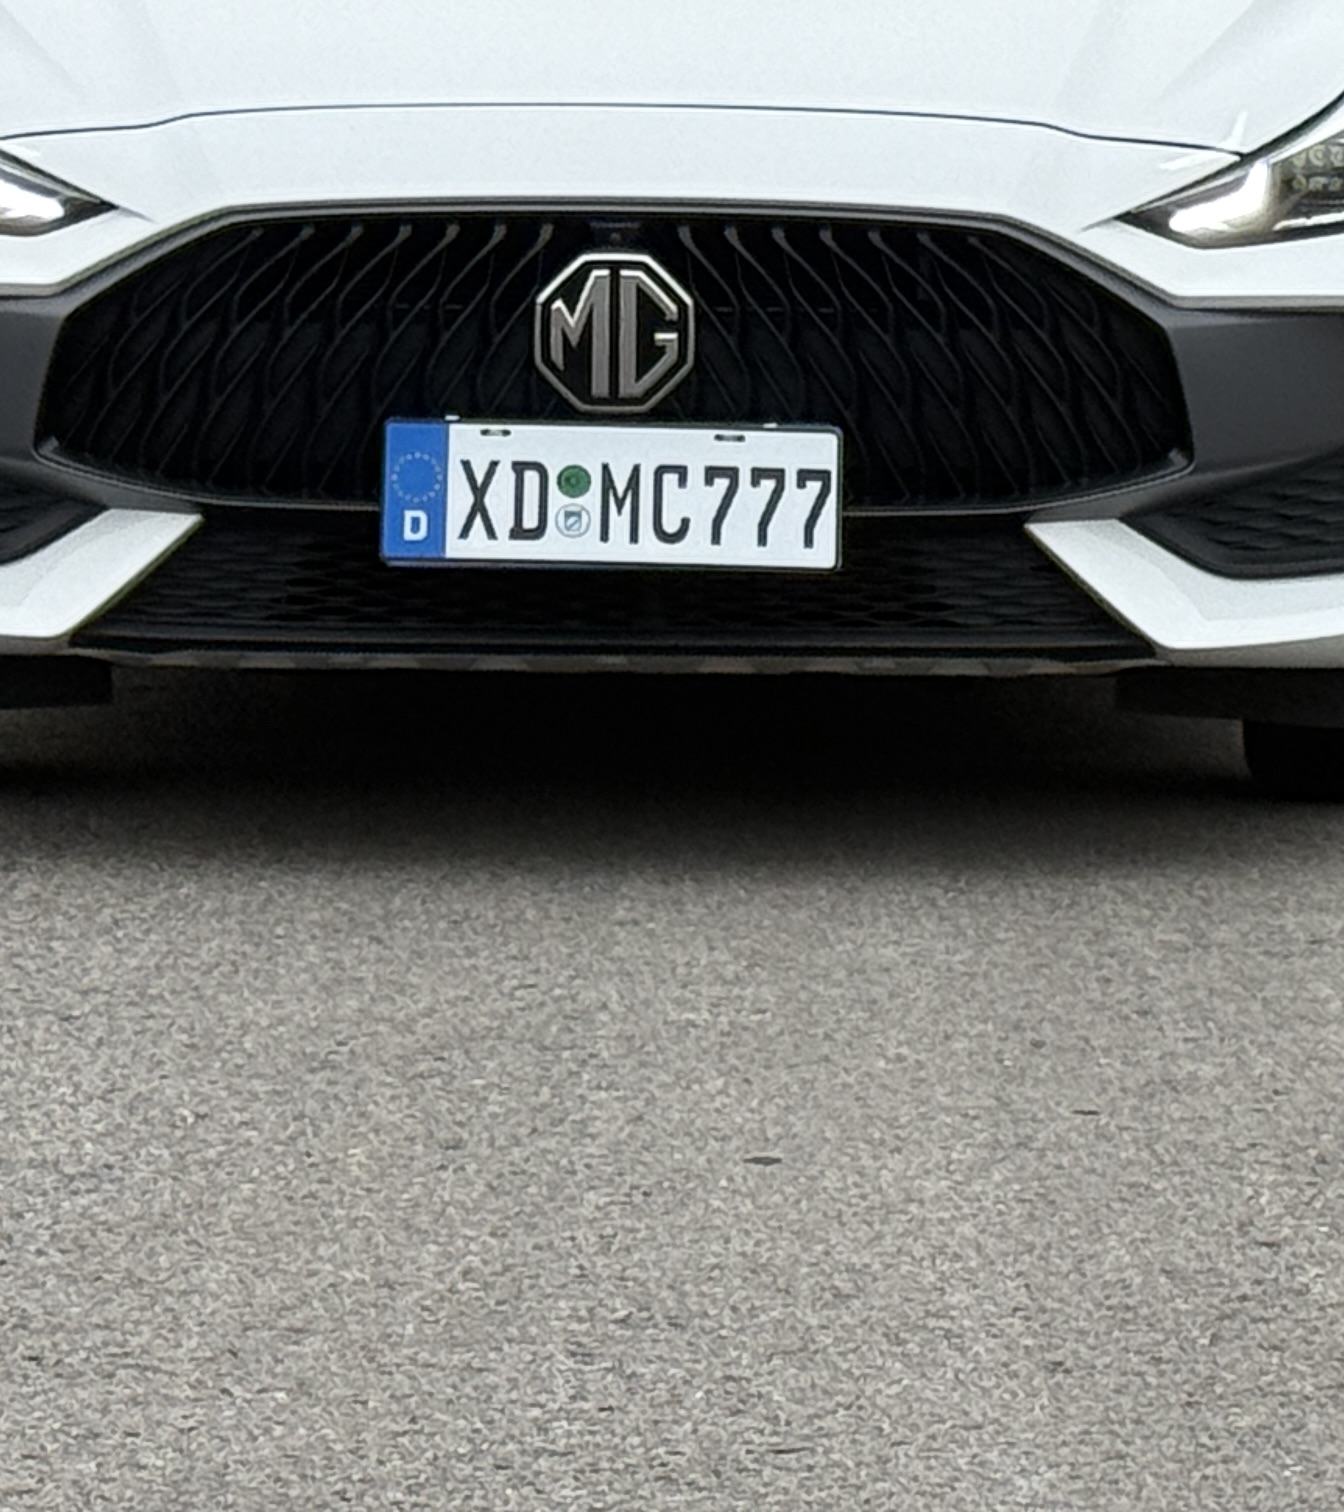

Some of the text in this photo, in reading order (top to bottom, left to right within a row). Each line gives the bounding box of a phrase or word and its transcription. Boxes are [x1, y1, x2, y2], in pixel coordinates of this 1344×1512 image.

[552, 269, 678, 398] MG
[403, 510, 428, 541] D
[458, 459, 832, 548] XD MC777
